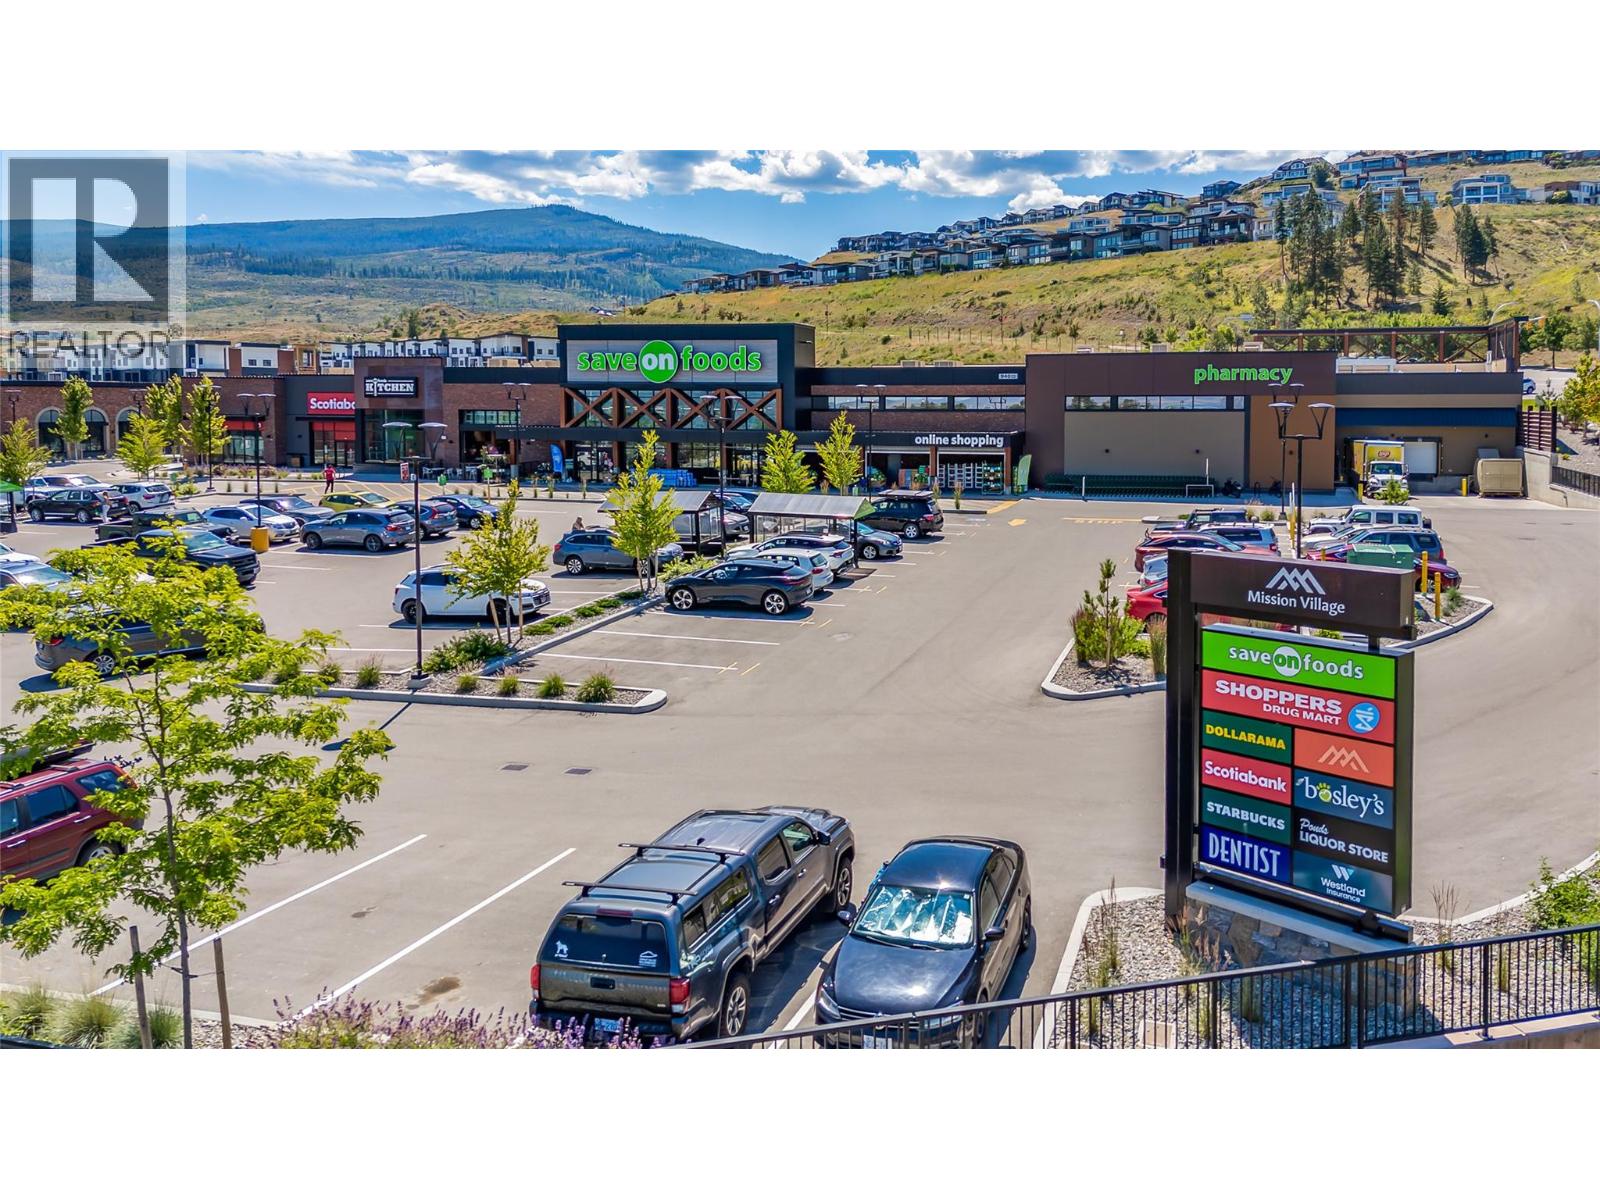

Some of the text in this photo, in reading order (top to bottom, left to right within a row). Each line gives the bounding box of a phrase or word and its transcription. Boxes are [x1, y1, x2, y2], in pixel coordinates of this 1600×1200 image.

[577, 345, 761, 372] save on foods
[1194, 364, 1293, 385] pharmacy
[914, 434, 1004, 449] online shopping
[1247, 590, 1345, 616] Mission Village
[1229, 645, 1364, 680] save on foods
[1215, 680, 1342, 714] SHOPPERS
[1263, 704, 1342, 726] DRUG MART
[1205, 724, 1286, 750] DOLLARAMA
[1204, 761, 1287, 793] Scotiabank
[1206, 801, 1285, 831] STARBUCKS
[1299, 817, 1329, 836] Ponds
[1208, 832, 1281, 877] DENTIST
[1299, 832, 1389, 864] LIQUOR STORE
[1320, 877, 1366, 898] Westland
[1326, 887, 1361, 903] Insurance
